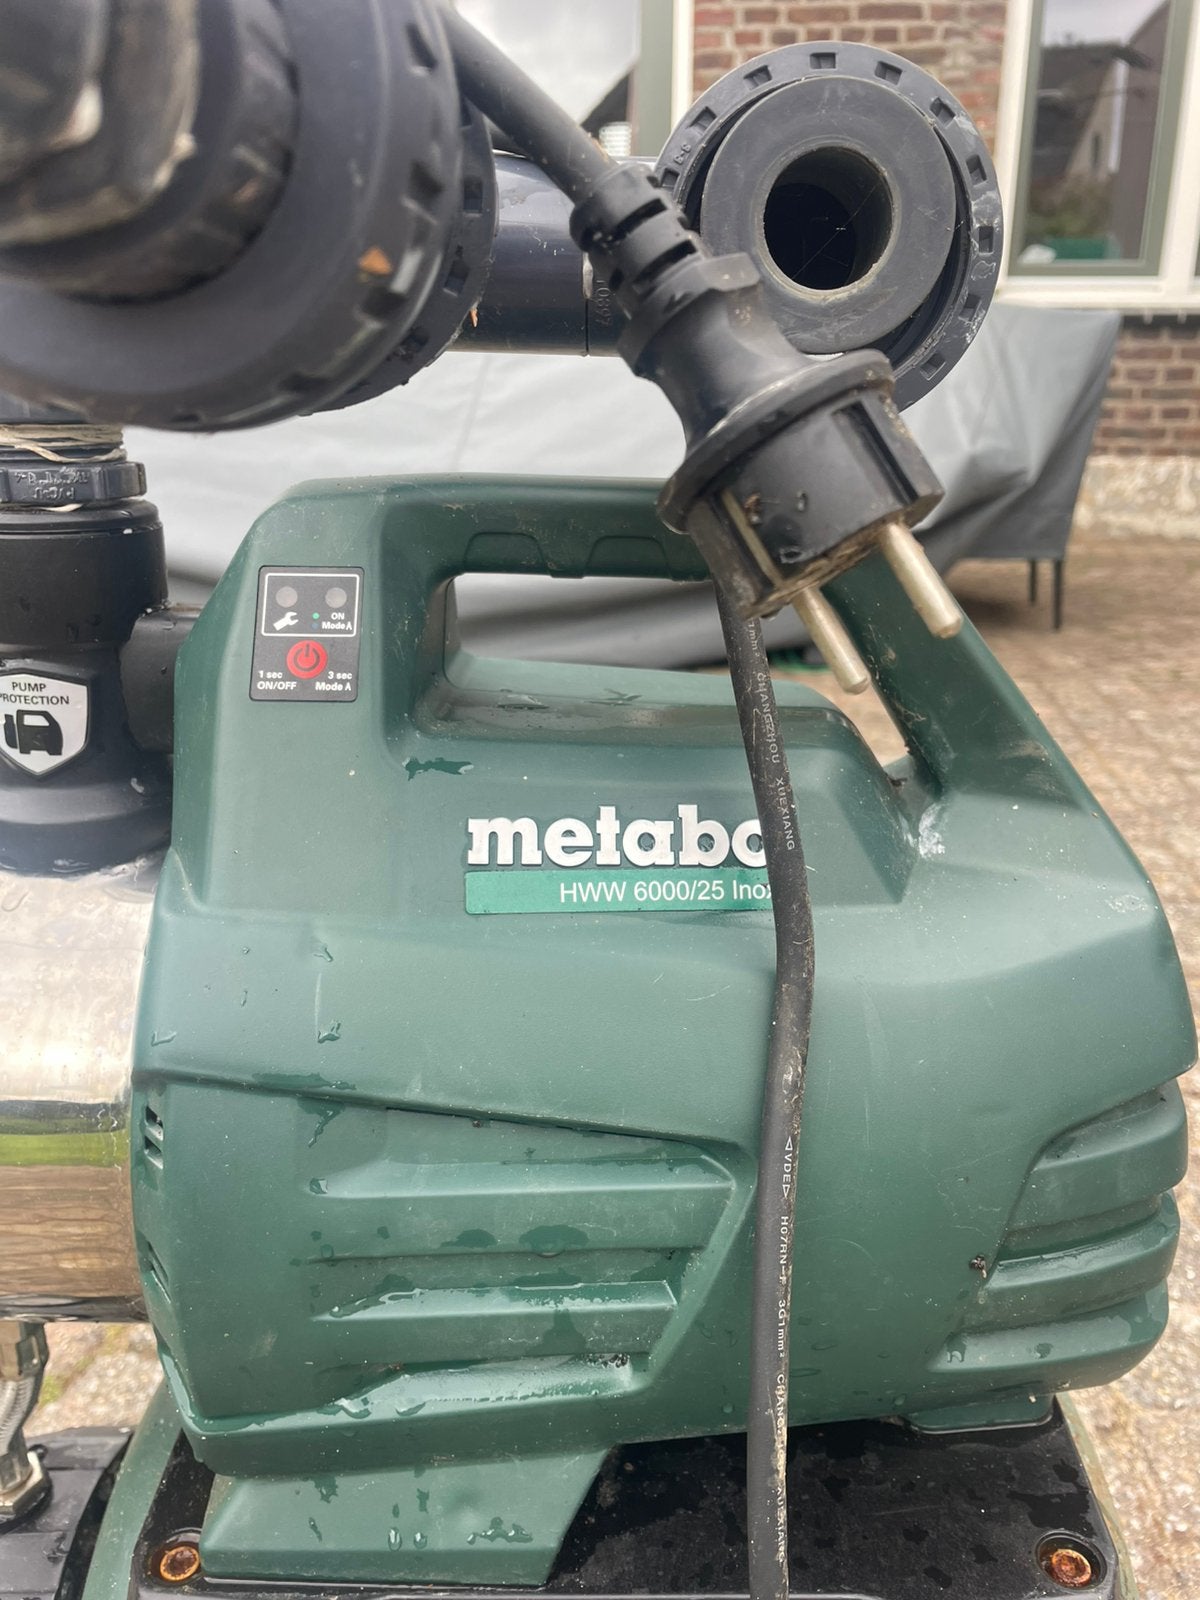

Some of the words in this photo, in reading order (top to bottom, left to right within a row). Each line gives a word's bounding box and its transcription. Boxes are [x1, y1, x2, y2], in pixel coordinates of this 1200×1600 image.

[331, 612, 345, 620] ON
[321, 621, 345, 630] Mode
[345, 622, 353, 631] A
[259, 670, 264, 678] 1
[266, 671, 283, 679] sec
[327, 670, 334, 679] 3
[336, 672, 353, 680] sec
[12, 681, 47, 692] PUMP
[257, 681, 297, 690] ON/OFF
[315, 682, 343, 691] Mode
[345, 683, 351, 691] A
[755, 672, 780, 764] CHANGZHOU
[775, 777, 795, 851] XUEXIANG
[560, 881, 626, 903] HWW
[633, 880, 725, 902] 6000/25
[783, 1153, 792, 1183] VDE
[780, 1216, 789, 1285] H07RN-F
